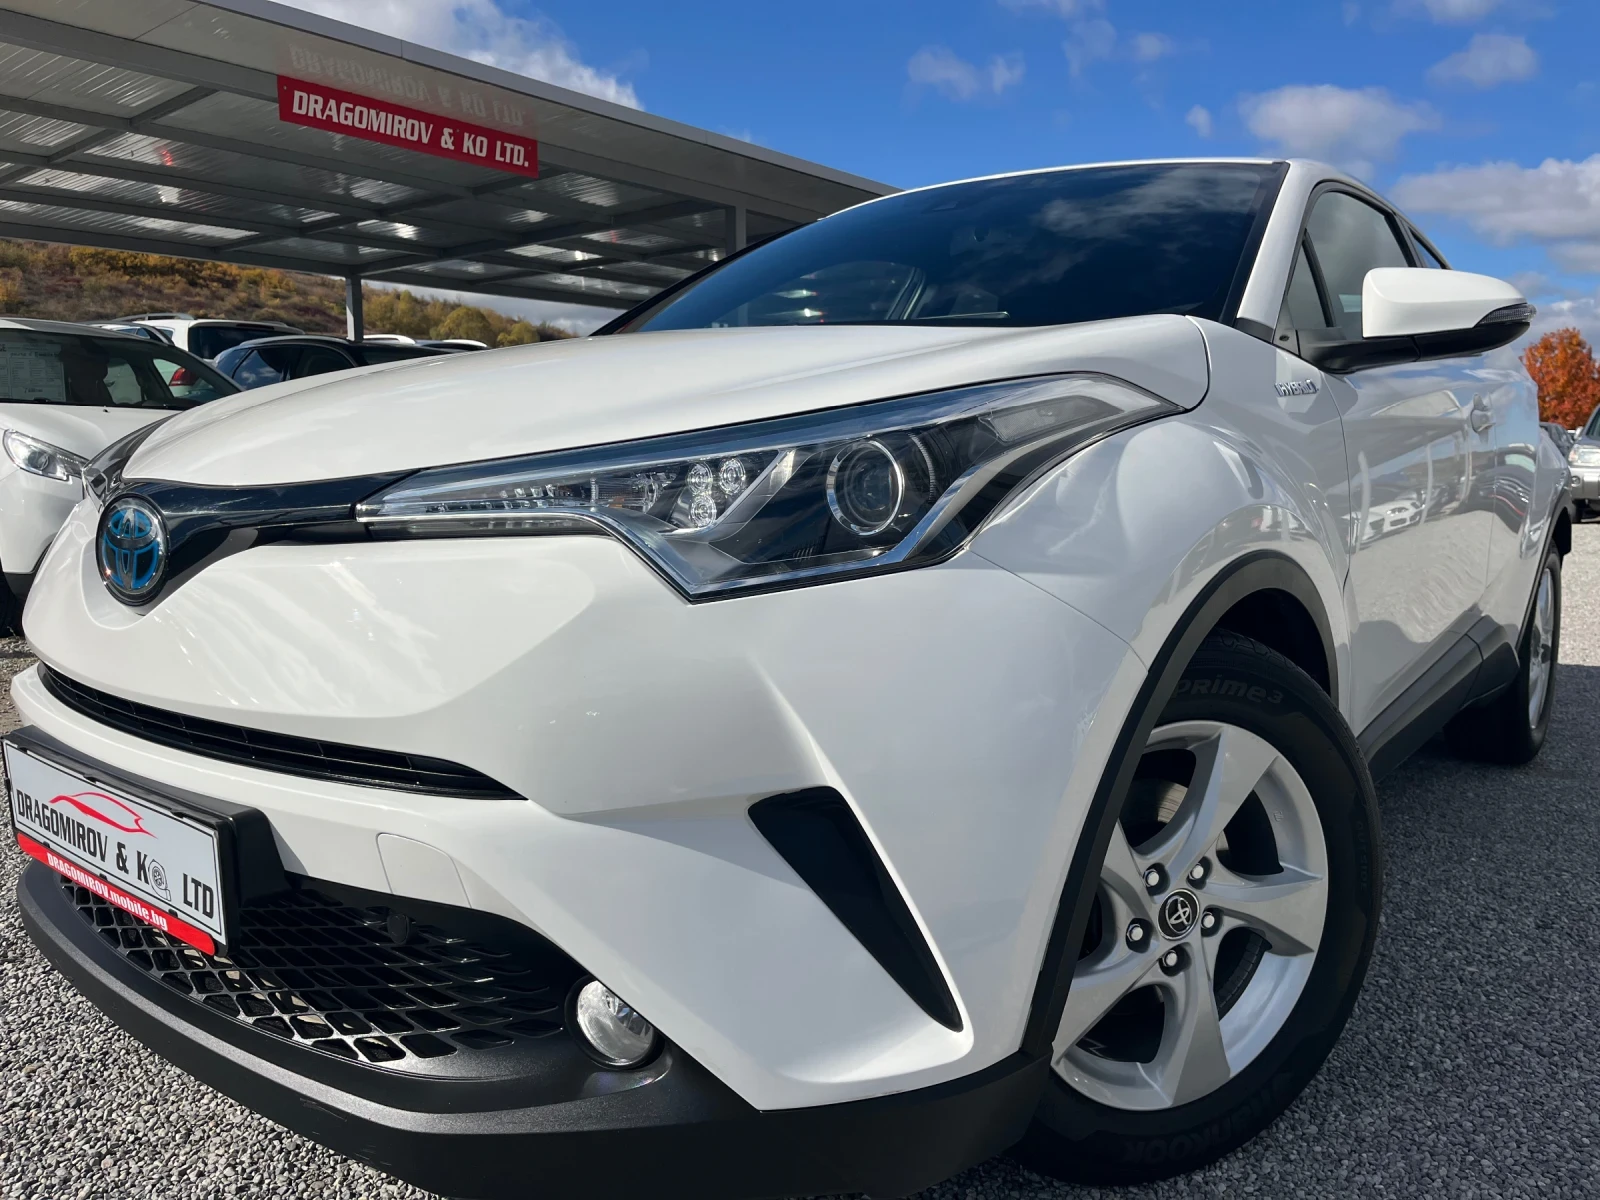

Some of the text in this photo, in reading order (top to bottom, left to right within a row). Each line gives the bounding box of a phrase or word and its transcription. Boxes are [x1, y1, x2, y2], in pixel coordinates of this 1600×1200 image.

[292, 90, 529, 167] DRAGOMIROV & KO LTD.
[16, 788, 108, 863] DRAGOMIROV
[116, 841, 129, 874] &
[183, 872, 214, 920] LTD
[47, 852, 168, 931] DRAGOMIROV.mobile.bg
